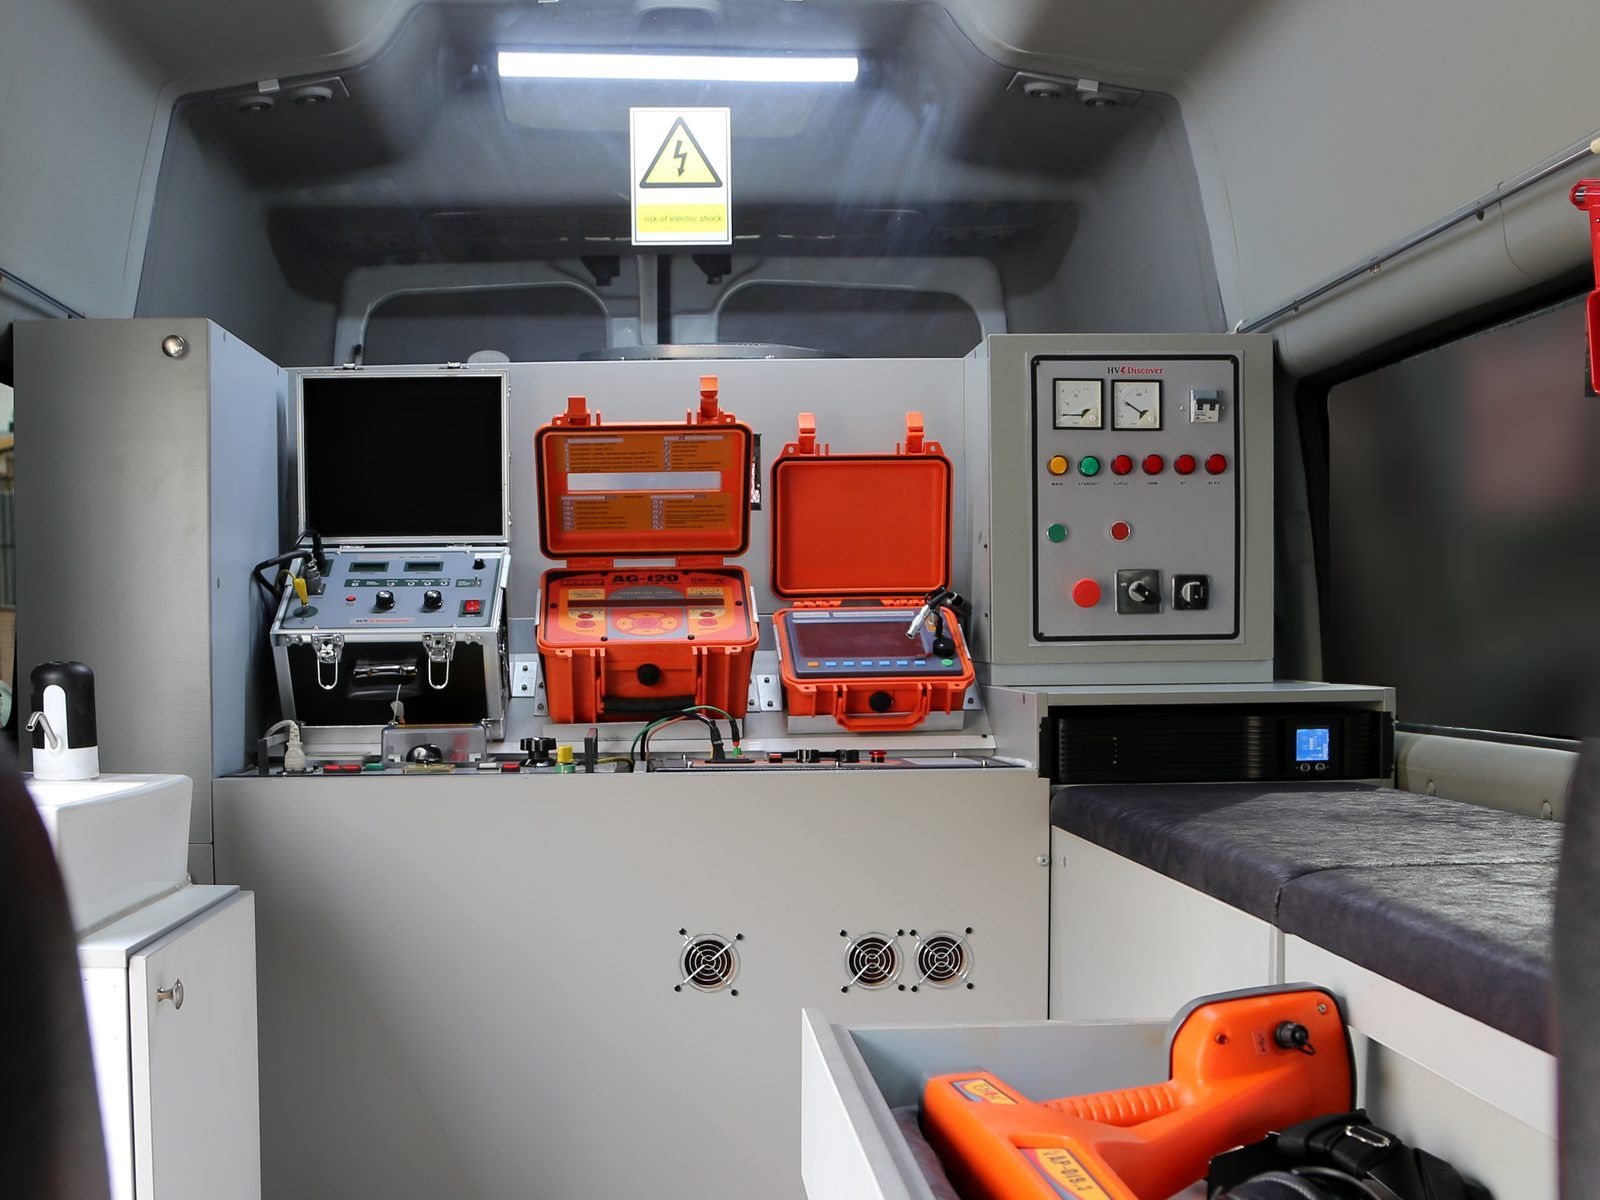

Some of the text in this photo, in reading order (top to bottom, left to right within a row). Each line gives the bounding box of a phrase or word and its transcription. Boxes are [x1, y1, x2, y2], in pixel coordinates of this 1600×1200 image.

[644, 213, 722, 223] risk of electric shock
[1107, 366, 1164, 375] HV Discover
[612, 574, 679, 582] AG-120
